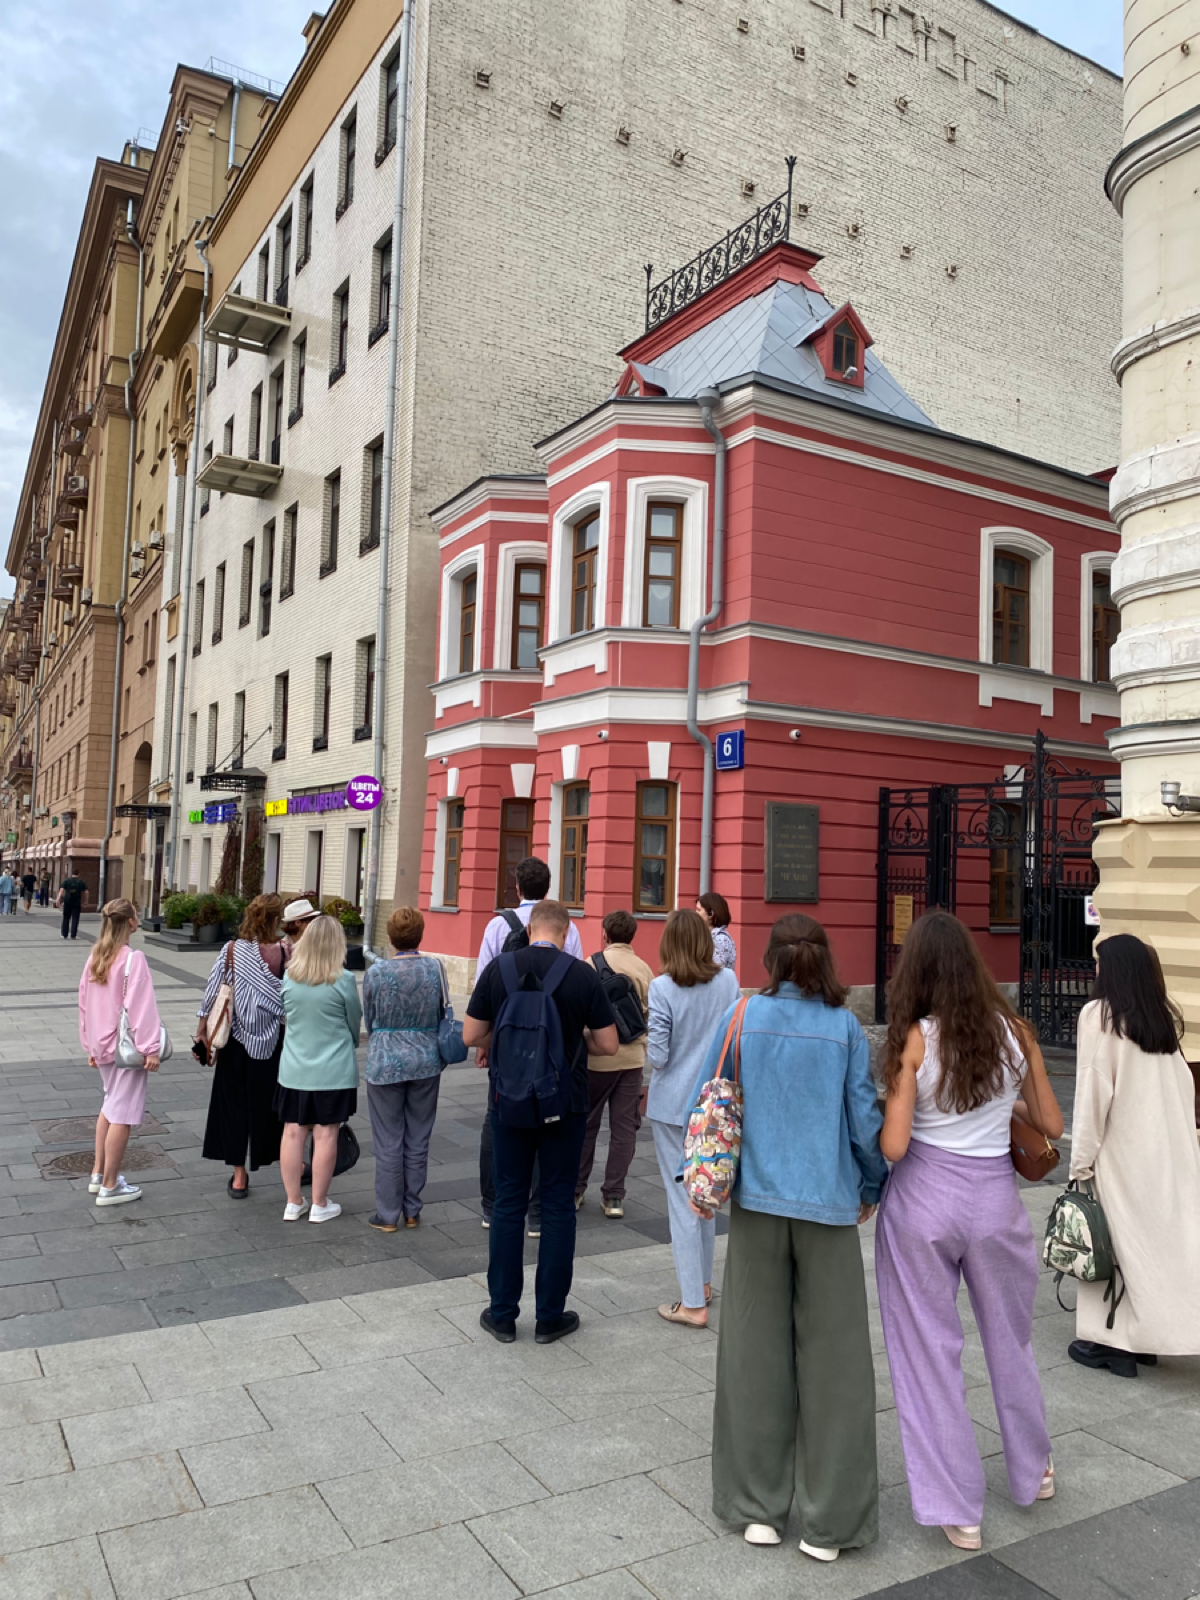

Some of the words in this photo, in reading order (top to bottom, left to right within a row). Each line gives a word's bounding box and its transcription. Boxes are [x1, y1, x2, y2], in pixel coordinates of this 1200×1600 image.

[723, 737, 732, 757] 6
[351, 781, 380, 792] ЦВЕТЫ
[355, 791, 374, 804] 24
